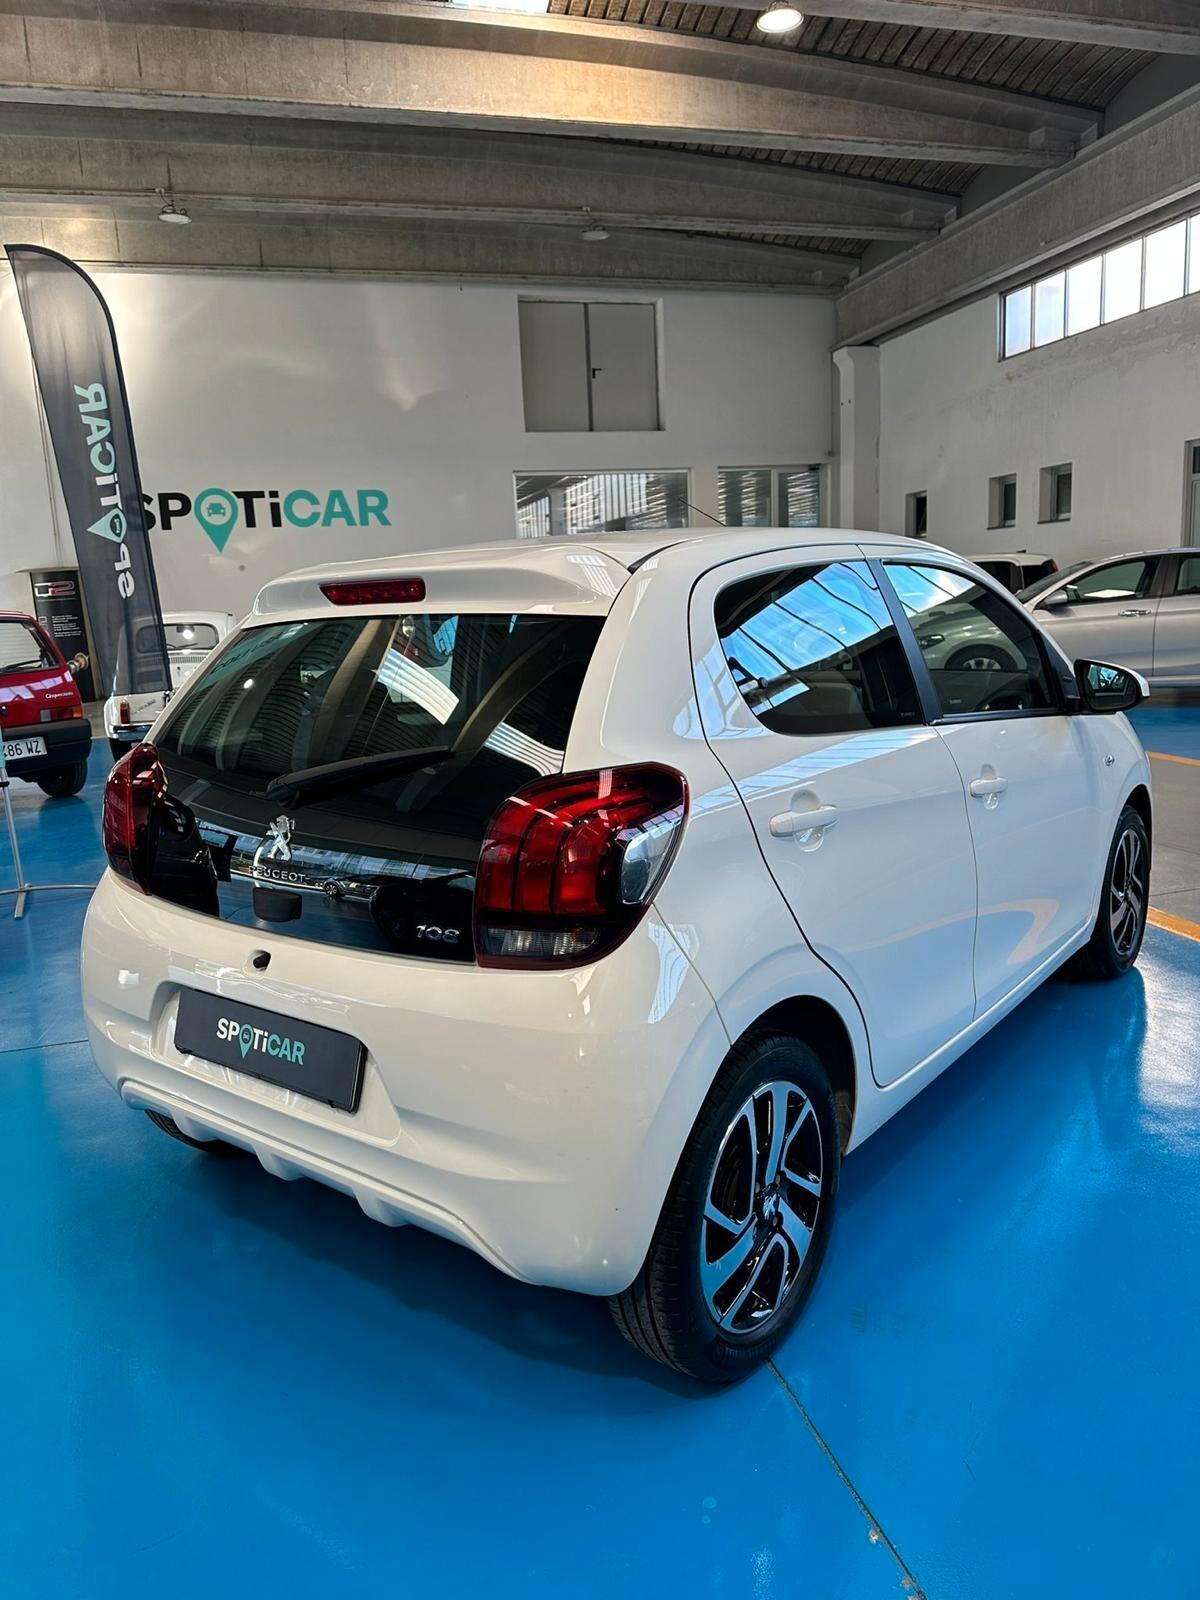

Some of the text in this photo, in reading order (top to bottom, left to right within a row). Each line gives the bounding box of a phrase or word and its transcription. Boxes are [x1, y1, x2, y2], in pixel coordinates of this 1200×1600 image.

[26, 740, 42, 755] WZ
[248, 864, 306, 882] PEUGEOT
[416, 924, 460, 944] 108
